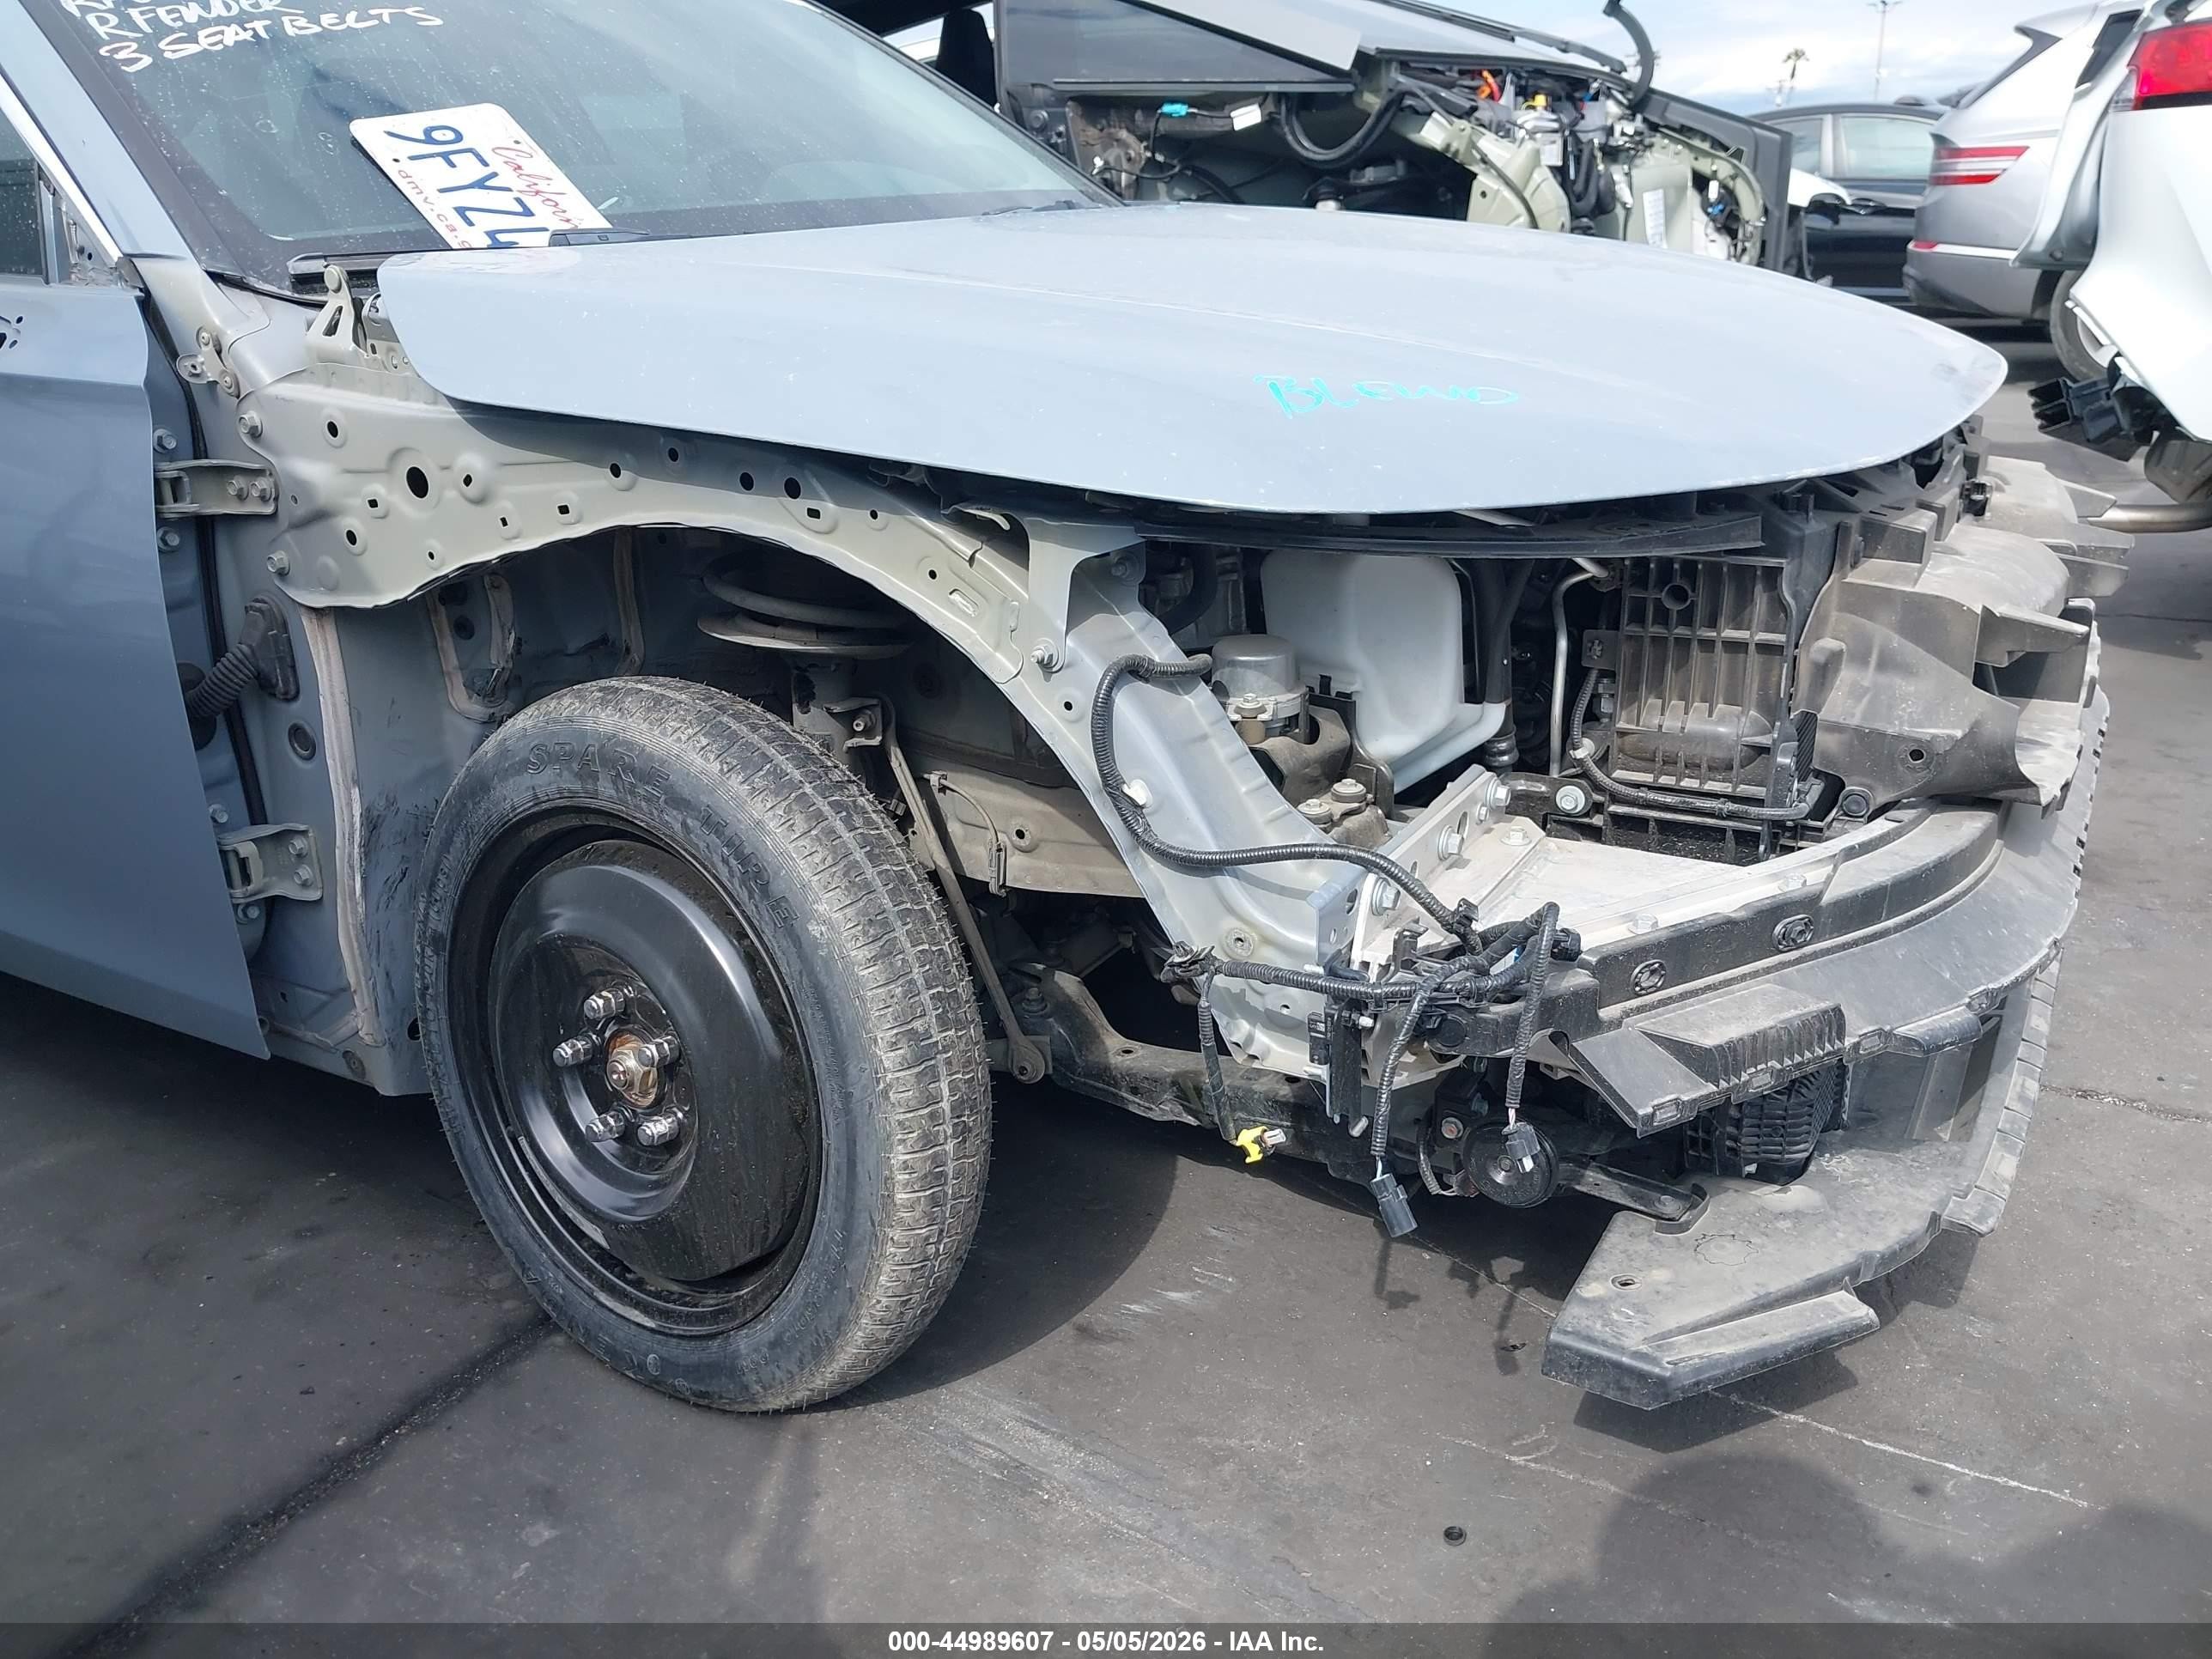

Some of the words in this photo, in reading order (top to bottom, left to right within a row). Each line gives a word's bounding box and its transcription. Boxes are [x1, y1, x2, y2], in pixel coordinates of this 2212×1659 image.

[85, 13, 143, 40] R
[99, 41, 153, 73] 3
[158, 20, 272, 59] SEAT
[282, 7, 443, 37] BELTS
[526, 741, 672, 799] SPARE
[698, 803, 801, 929] TIRE
